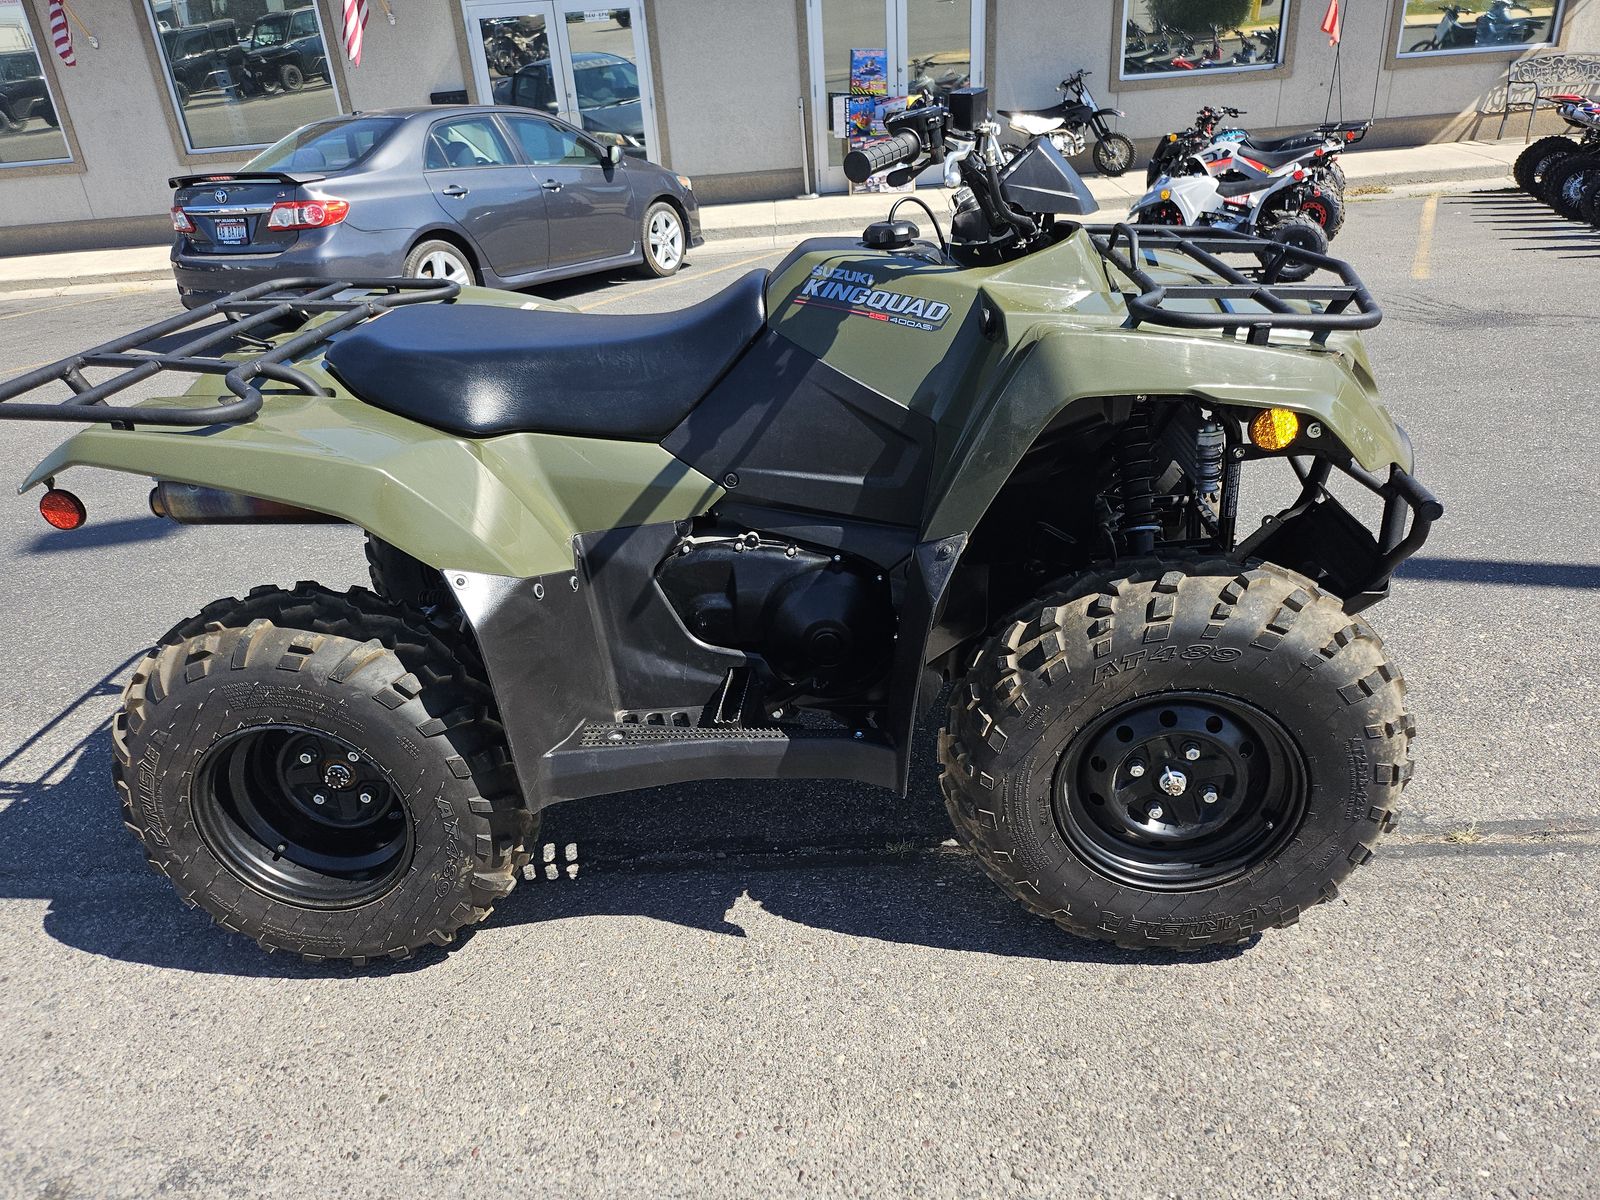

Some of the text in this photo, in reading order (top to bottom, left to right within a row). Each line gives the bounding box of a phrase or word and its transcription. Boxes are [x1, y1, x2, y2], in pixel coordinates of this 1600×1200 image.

[811, 264, 875, 286] SUZUKI
[801, 278, 951, 322] KINGQUAD
[1092, 643, 1243, 686] AT489
[139, 744, 170, 848] CARLISLE
[433, 795, 462, 899] AT489
[1122, 907, 1259, 937] CARLISLE
